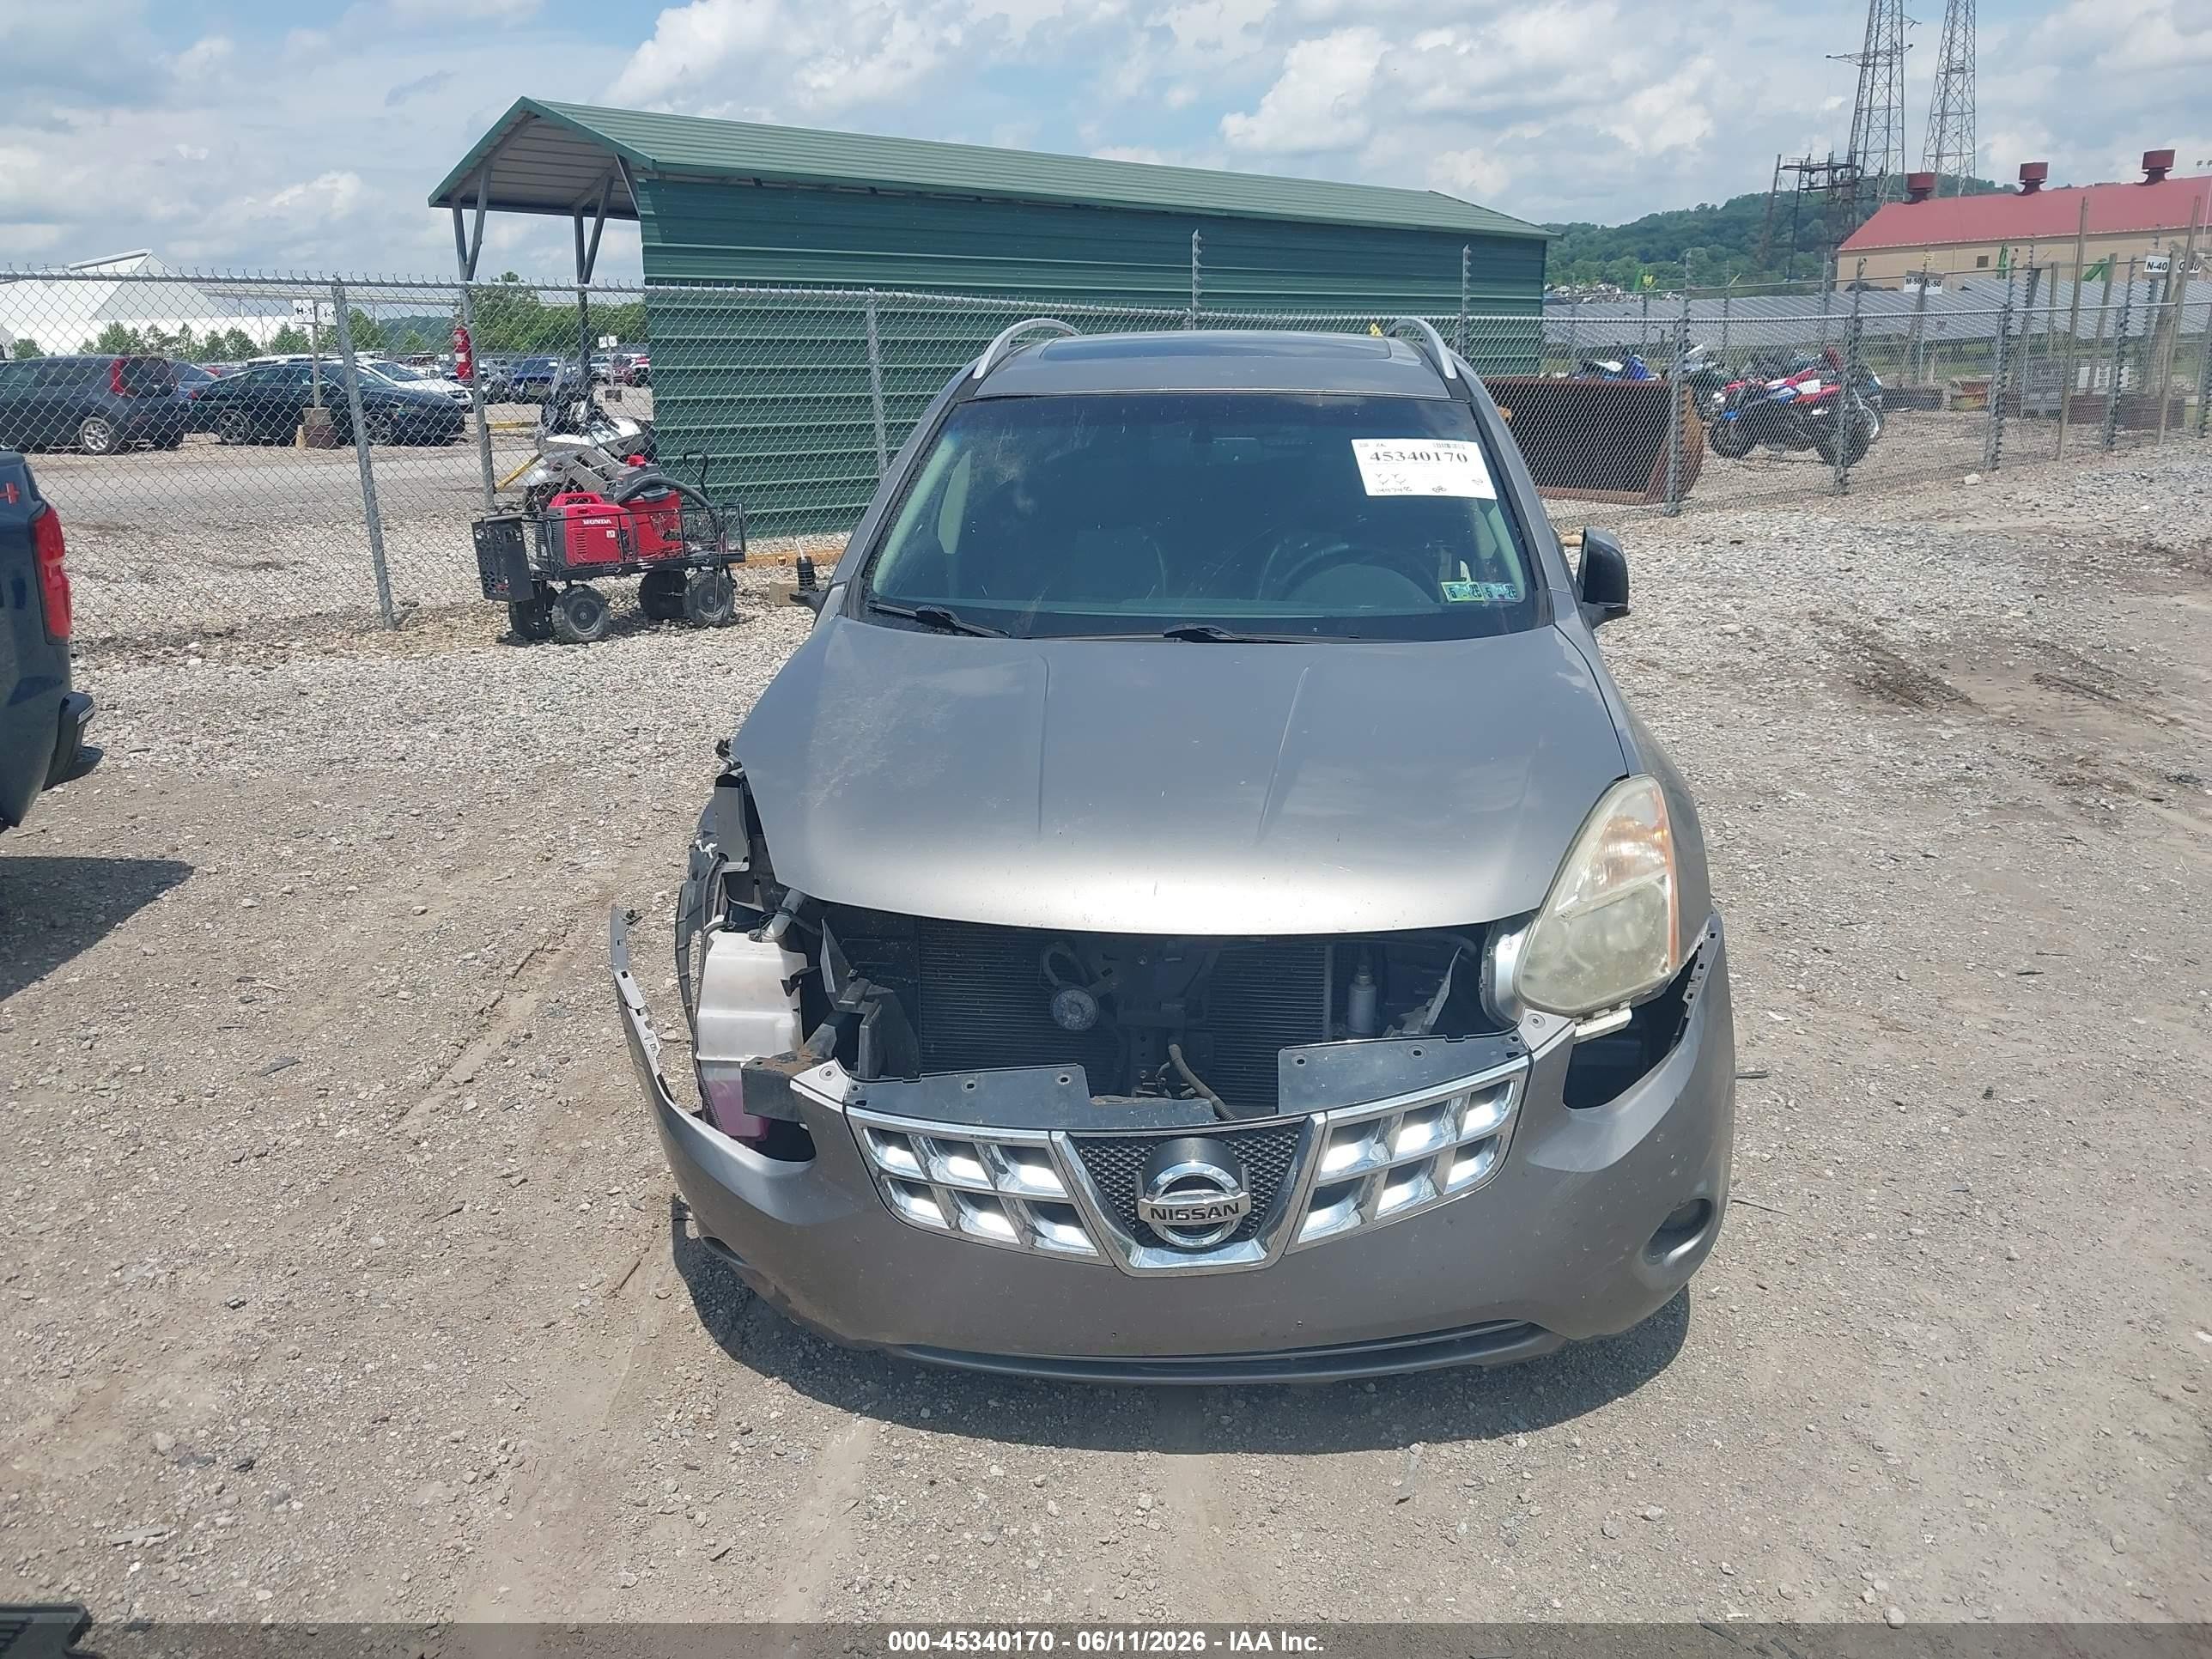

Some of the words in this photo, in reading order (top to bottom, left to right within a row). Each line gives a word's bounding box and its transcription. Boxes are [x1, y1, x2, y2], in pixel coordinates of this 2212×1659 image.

[2147, 261, 2168, 270] N-40
[1370, 451, 1468, 464] 45340170
[1449, 587, 1457, 599] 5
[1485, 586, 1493, 599] 5
[1150, 1202, 1239, 1221] NISSAN
